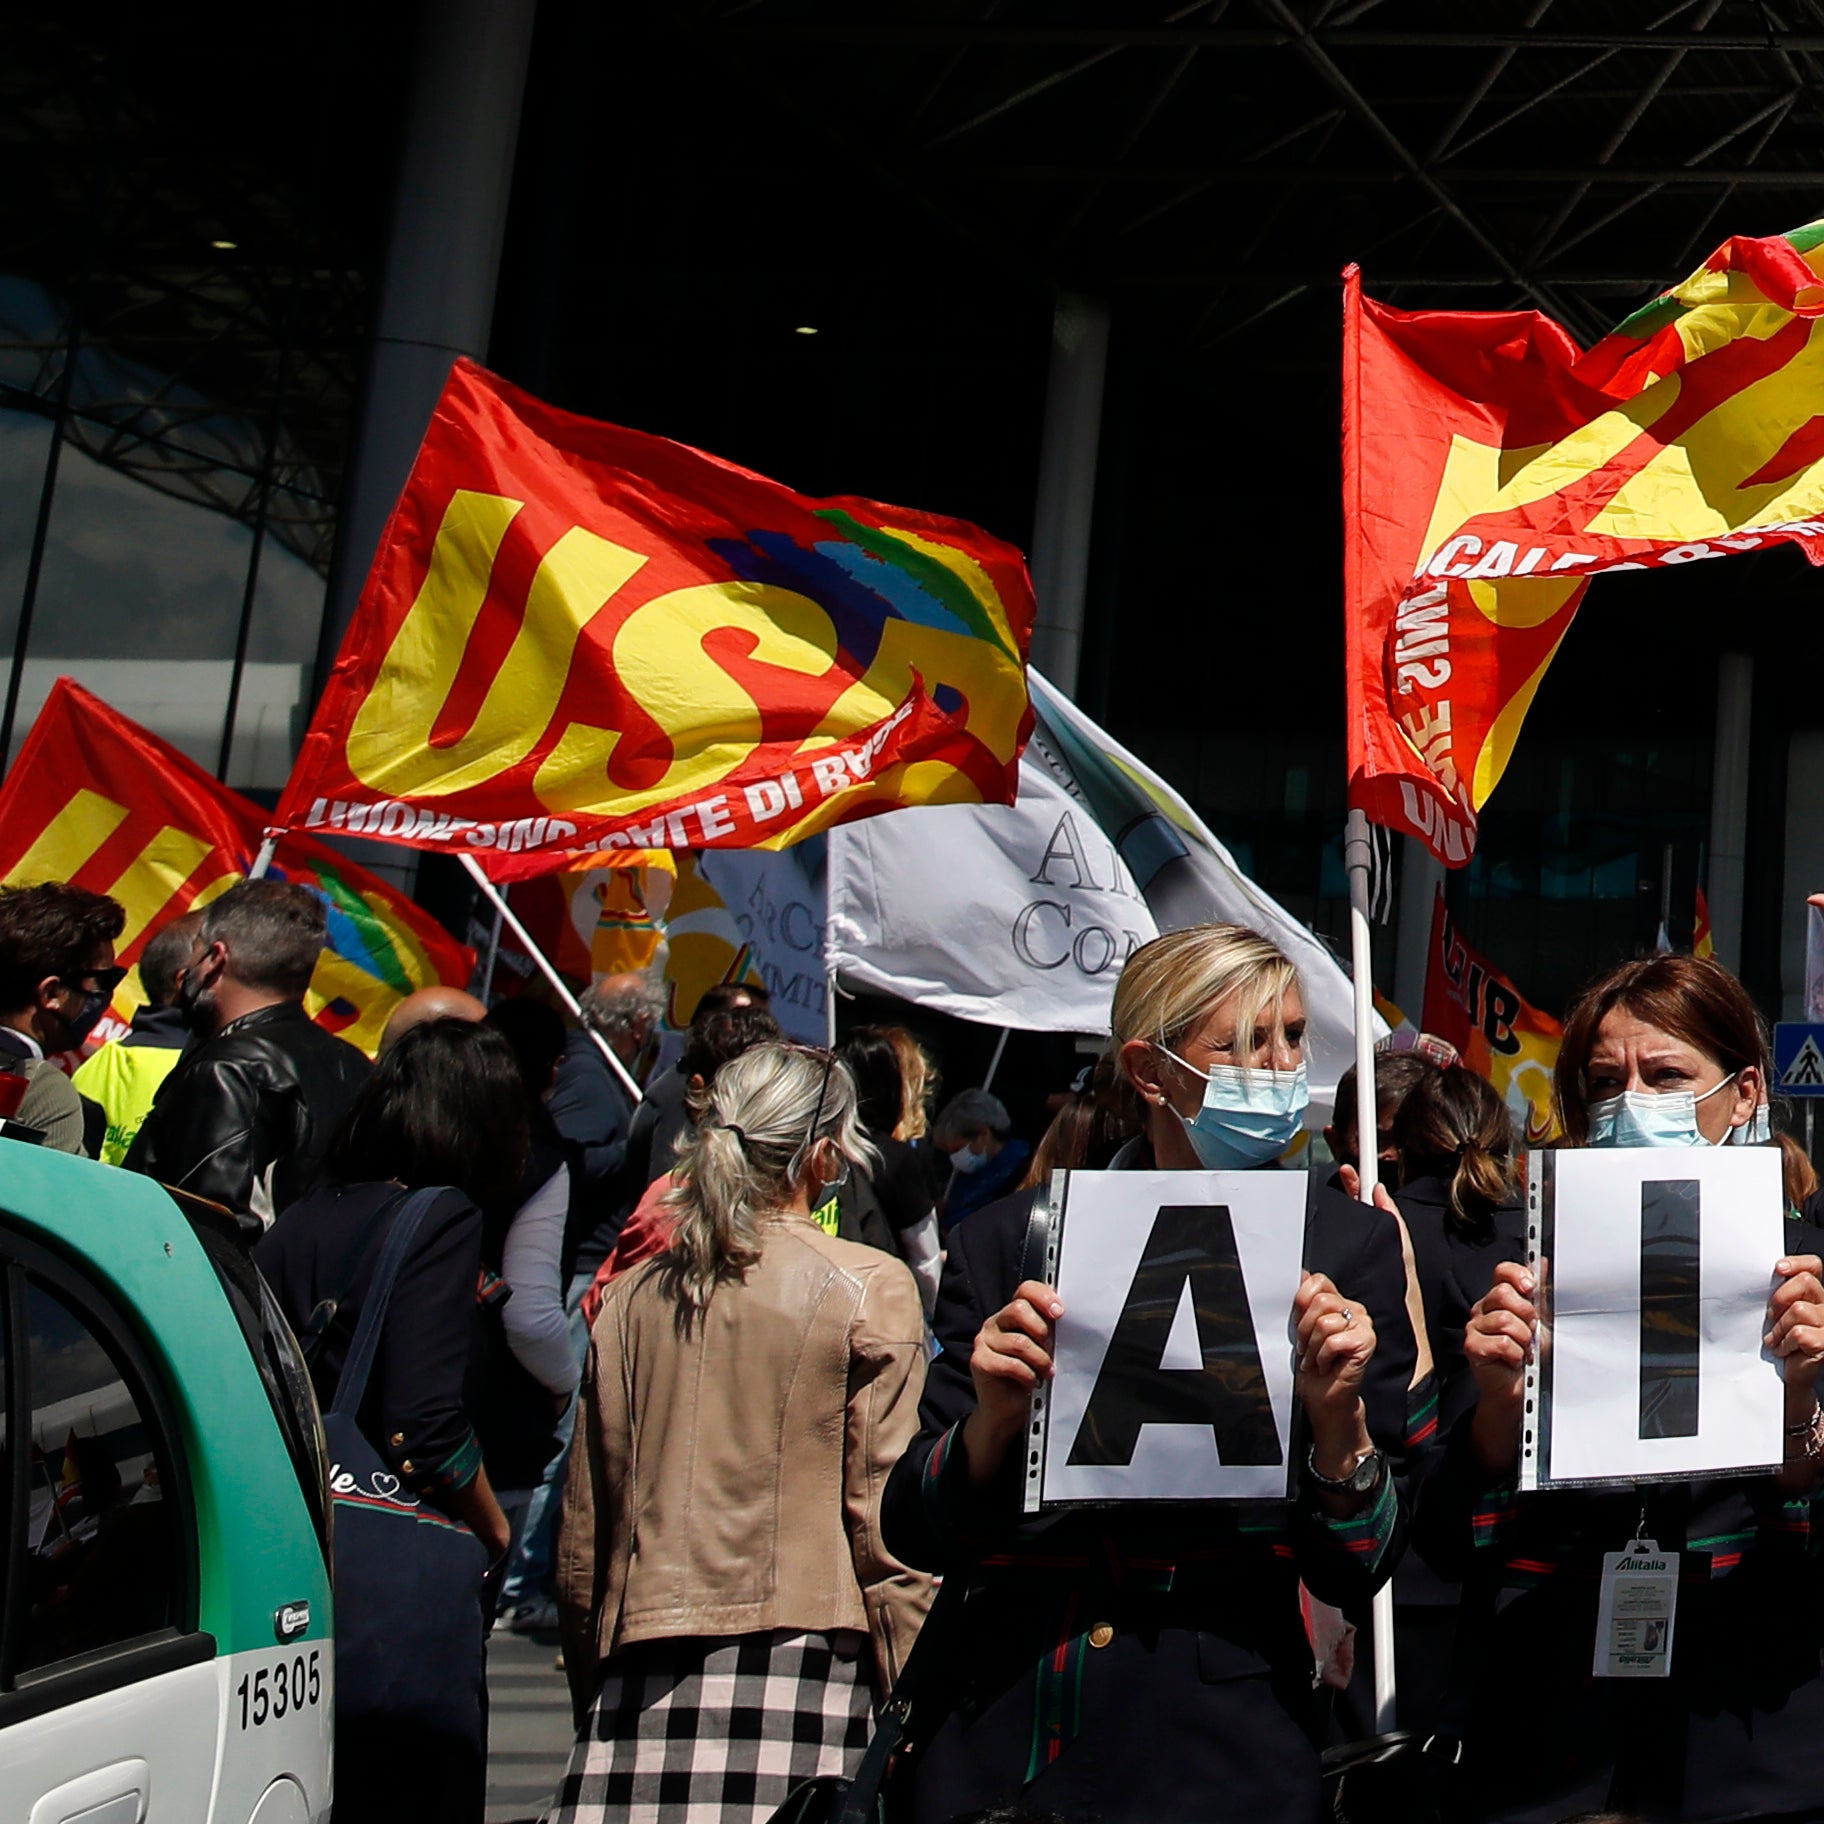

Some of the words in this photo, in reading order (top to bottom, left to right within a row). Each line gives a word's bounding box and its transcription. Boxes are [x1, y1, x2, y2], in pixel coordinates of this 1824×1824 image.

[743, 770, 804, 824] DI
[1066, 1205, 1284, 1466] A
[1638, 1179, 1701, 1440] I
[1614, 1556, 1667, 1571] Alitalia
[237, 1649, 321, 1731] 15305
